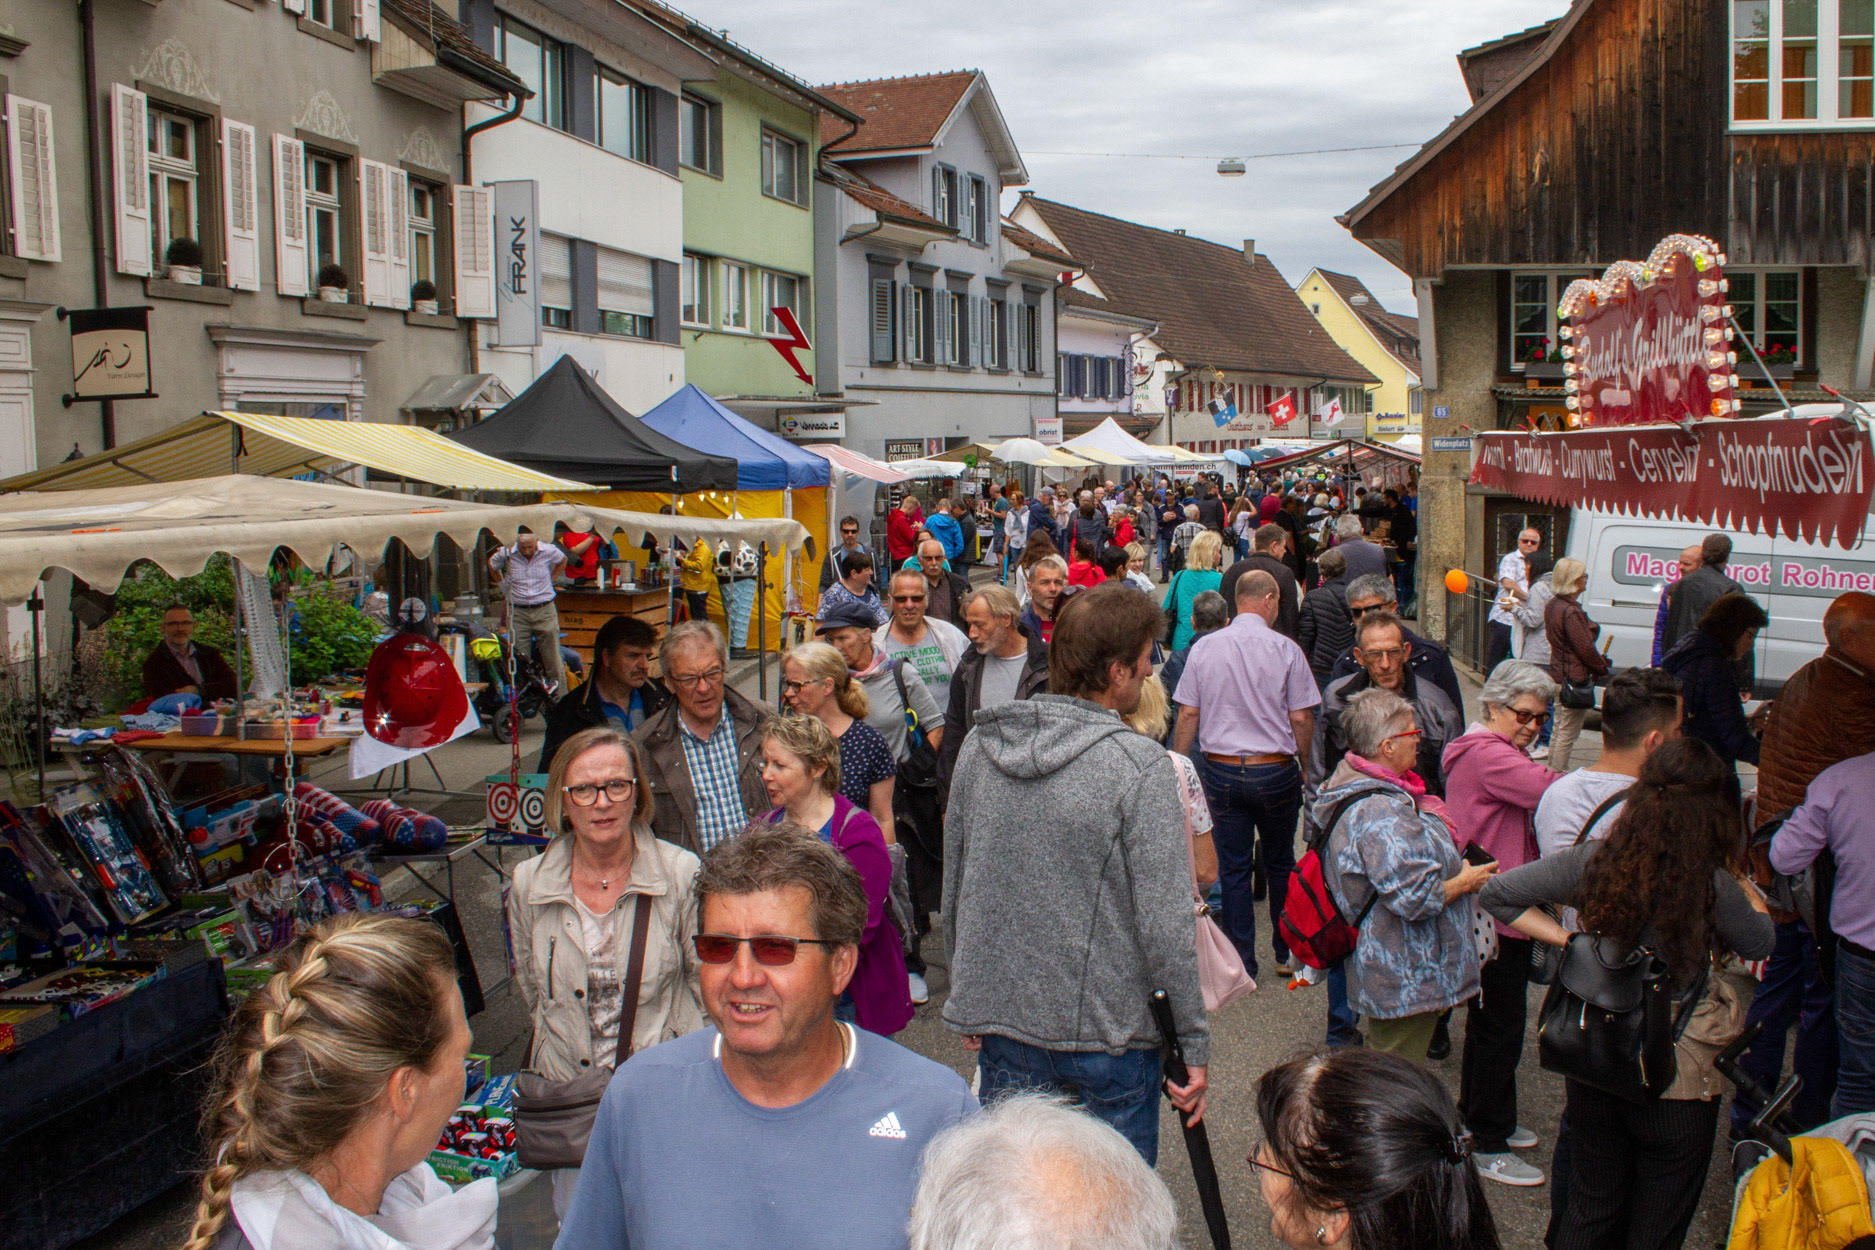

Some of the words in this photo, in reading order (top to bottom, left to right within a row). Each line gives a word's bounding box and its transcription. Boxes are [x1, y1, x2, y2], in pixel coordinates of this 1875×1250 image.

[510, 215, 528, 295] FRANK
[1580, 323, 1629, 391] Rudolf's
[1437, 408, 1447, 417] 65
[1038, 428, 1058, 436] obrist
[888, 444, 901, 453] ART
[901, 443, 919, 453] STYLE
[1433, 439, 1469, 450] Widenplatz
[1560, 439, 1617, 489] Currywurst
[1718, 430, 1863, 504] Schopfnudeln
[889, 649, 917, 661] ACTIVE
[935, 674, 950, 684] YOU
[869, 1127, 907, 1140] adidas
